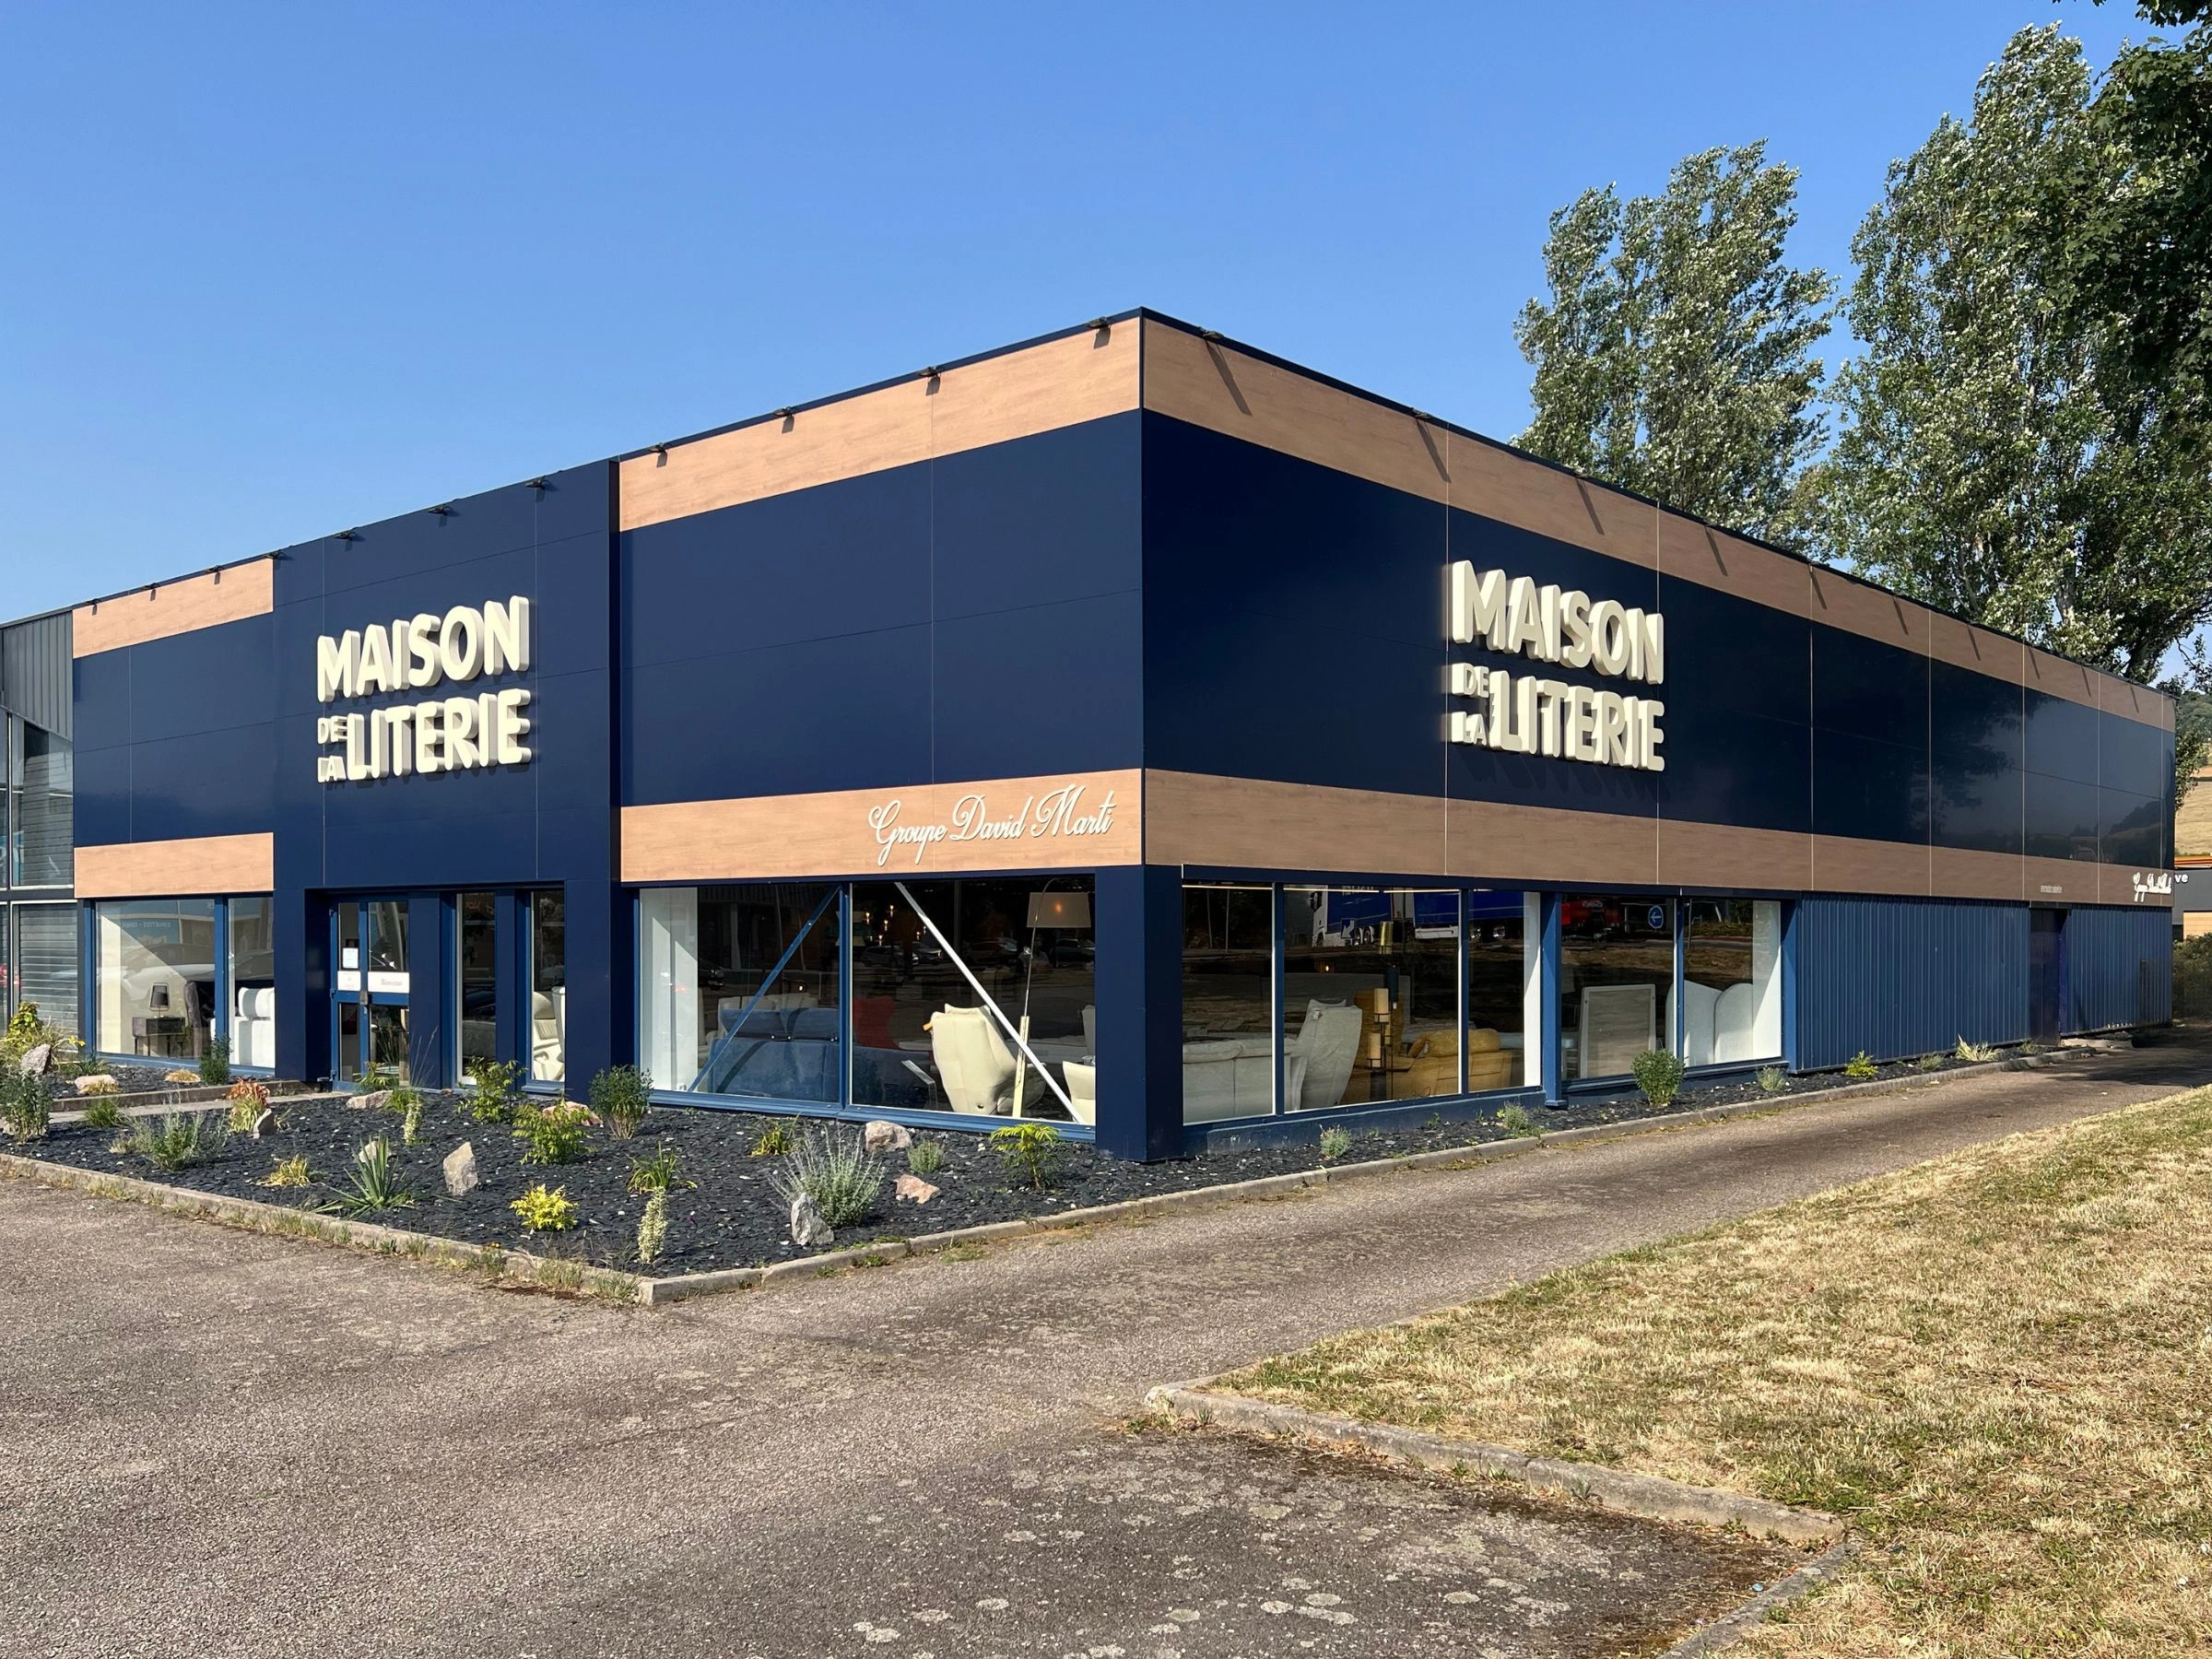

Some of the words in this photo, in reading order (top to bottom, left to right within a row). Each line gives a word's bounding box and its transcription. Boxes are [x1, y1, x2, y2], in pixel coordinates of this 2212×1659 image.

[317, 594, 530, 701] MAISON
[1452, 559, 1665, 685] MAISON
[1451, 662, 1489, 698] DE
[1488, 670, 1665, 771] LITERIE
[317, 715, 348, 745] DE
[317, 755, 347, 783] LA
[347, 688, 532, 781] LITERIE
[1451, 711, 1488, 747] LA
[867, 799, 947, 867] Groupe
[949, 794, 1034, 841] David
[1031, 783, 1118, 838] Marti
